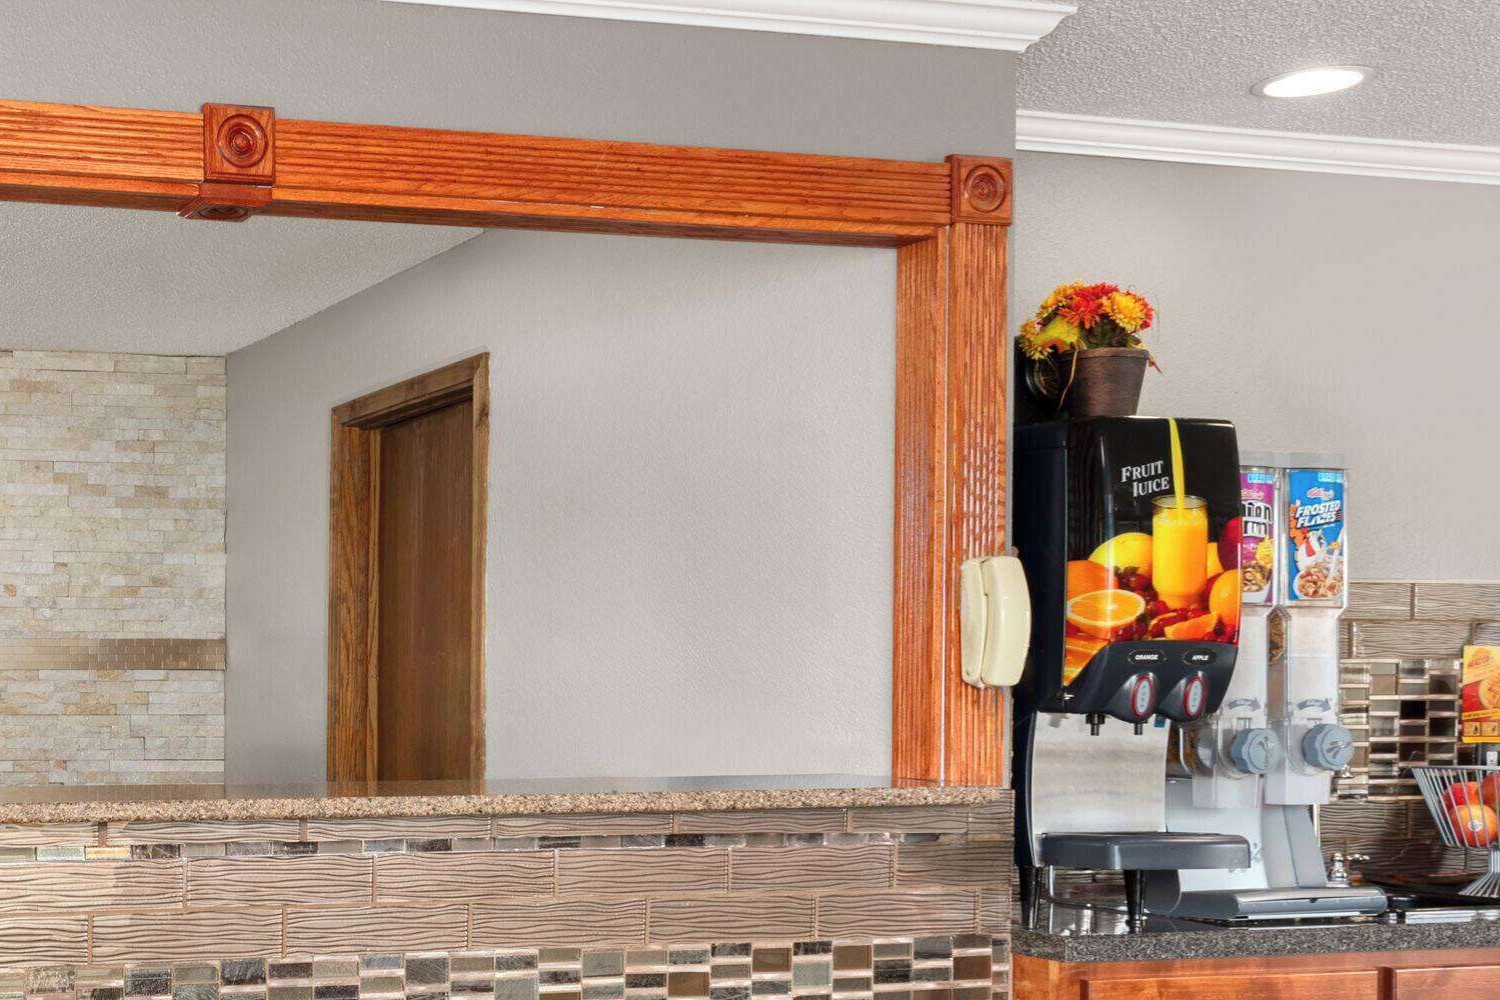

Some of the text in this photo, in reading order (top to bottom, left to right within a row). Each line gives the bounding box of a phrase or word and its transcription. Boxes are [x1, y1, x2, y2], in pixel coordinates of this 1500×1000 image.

[1120, 460, 1164, 483] FRUIT
[1132, 476, 1170, 498] JUICE
[1296, 500, 1341, 519] FROSTED
